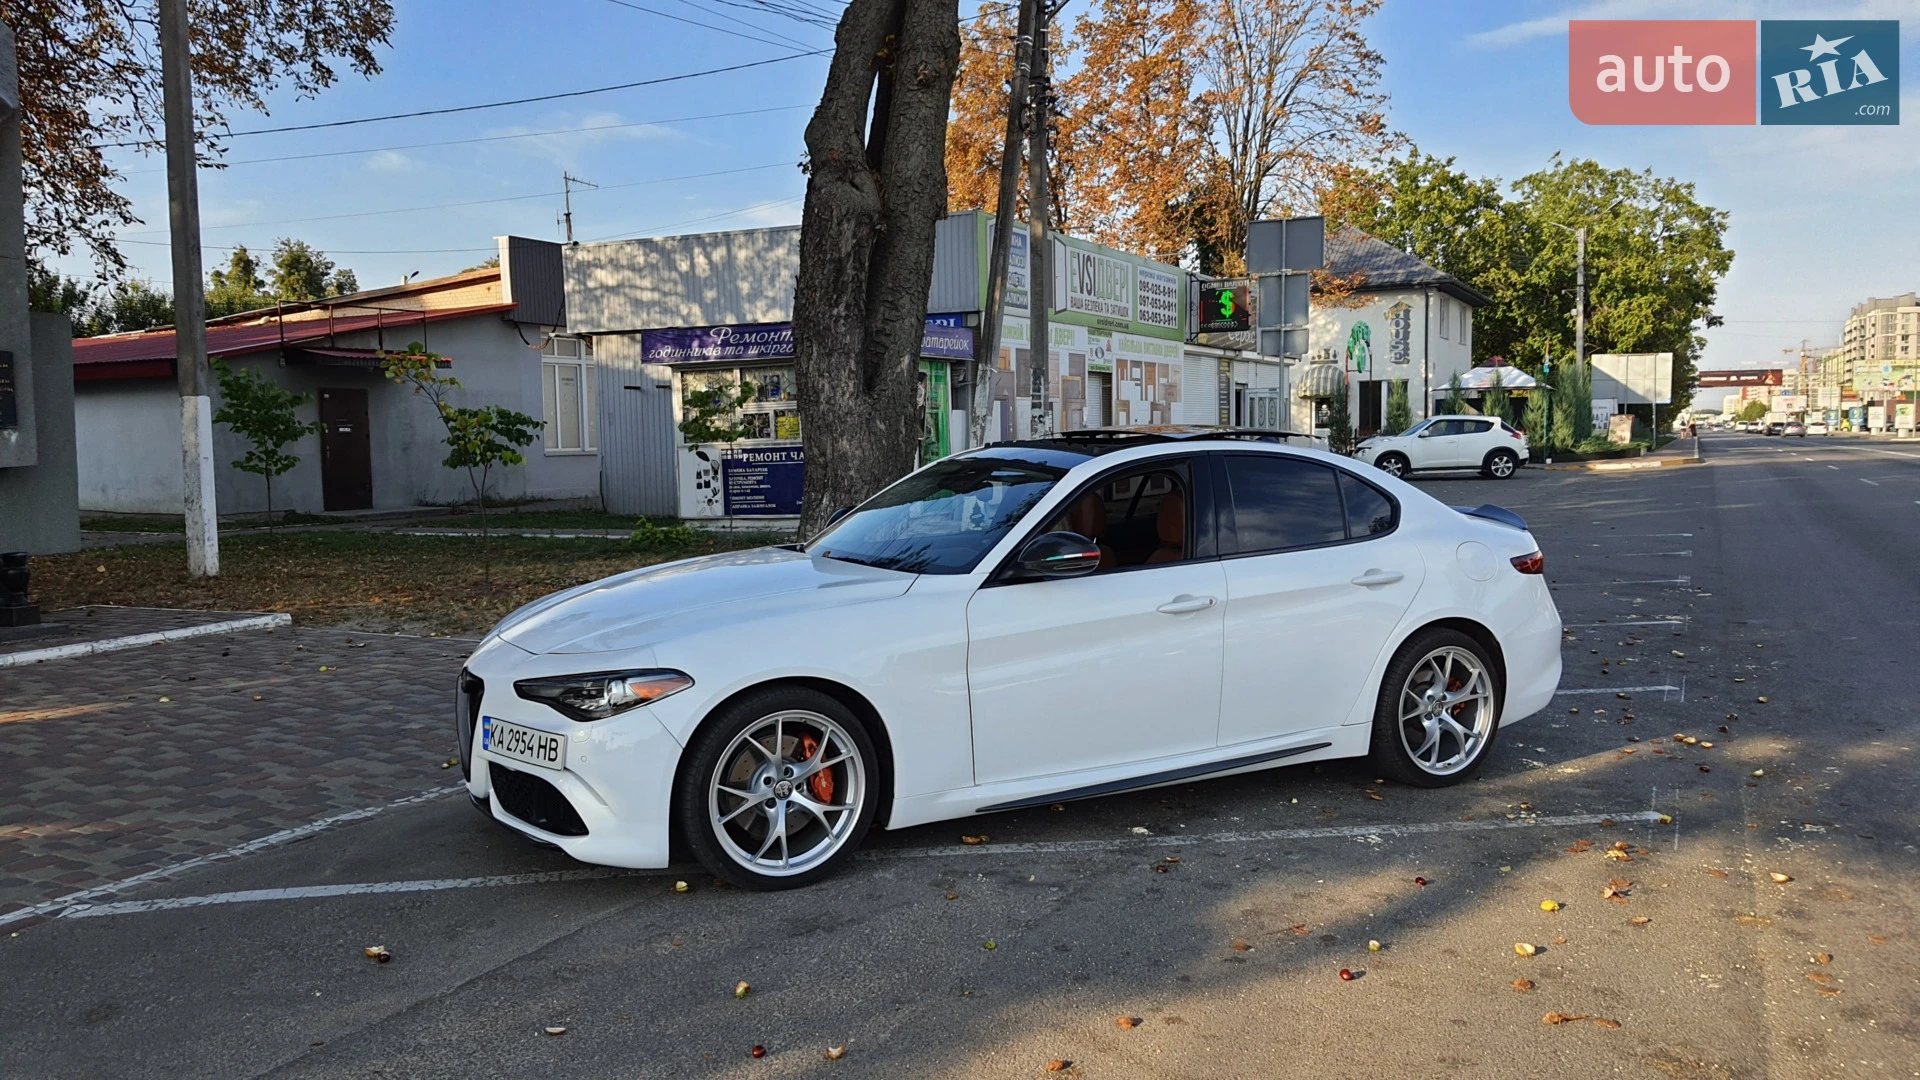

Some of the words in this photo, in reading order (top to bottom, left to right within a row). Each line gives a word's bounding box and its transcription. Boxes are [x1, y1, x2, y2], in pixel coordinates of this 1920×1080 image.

[1139, 280, 1177, 299] 095-025-8-911
[1084, 298, 1103, 313] БЕЗПЕКА
[1103, 303, 1109, 314] ТА
[1139, 295, 1177, 313] 097-053-0-911
[649, 343, 721, 359] годинників
[723, 345, 743, 355] та
[743, 452, 787, 462] РЕМОНТ
[790, 451, 804, 460] ЧА
[490, 723, 504, 749] KA
[506, 728, 535, 757] 2954
[537, 735, 559, 762] HB
